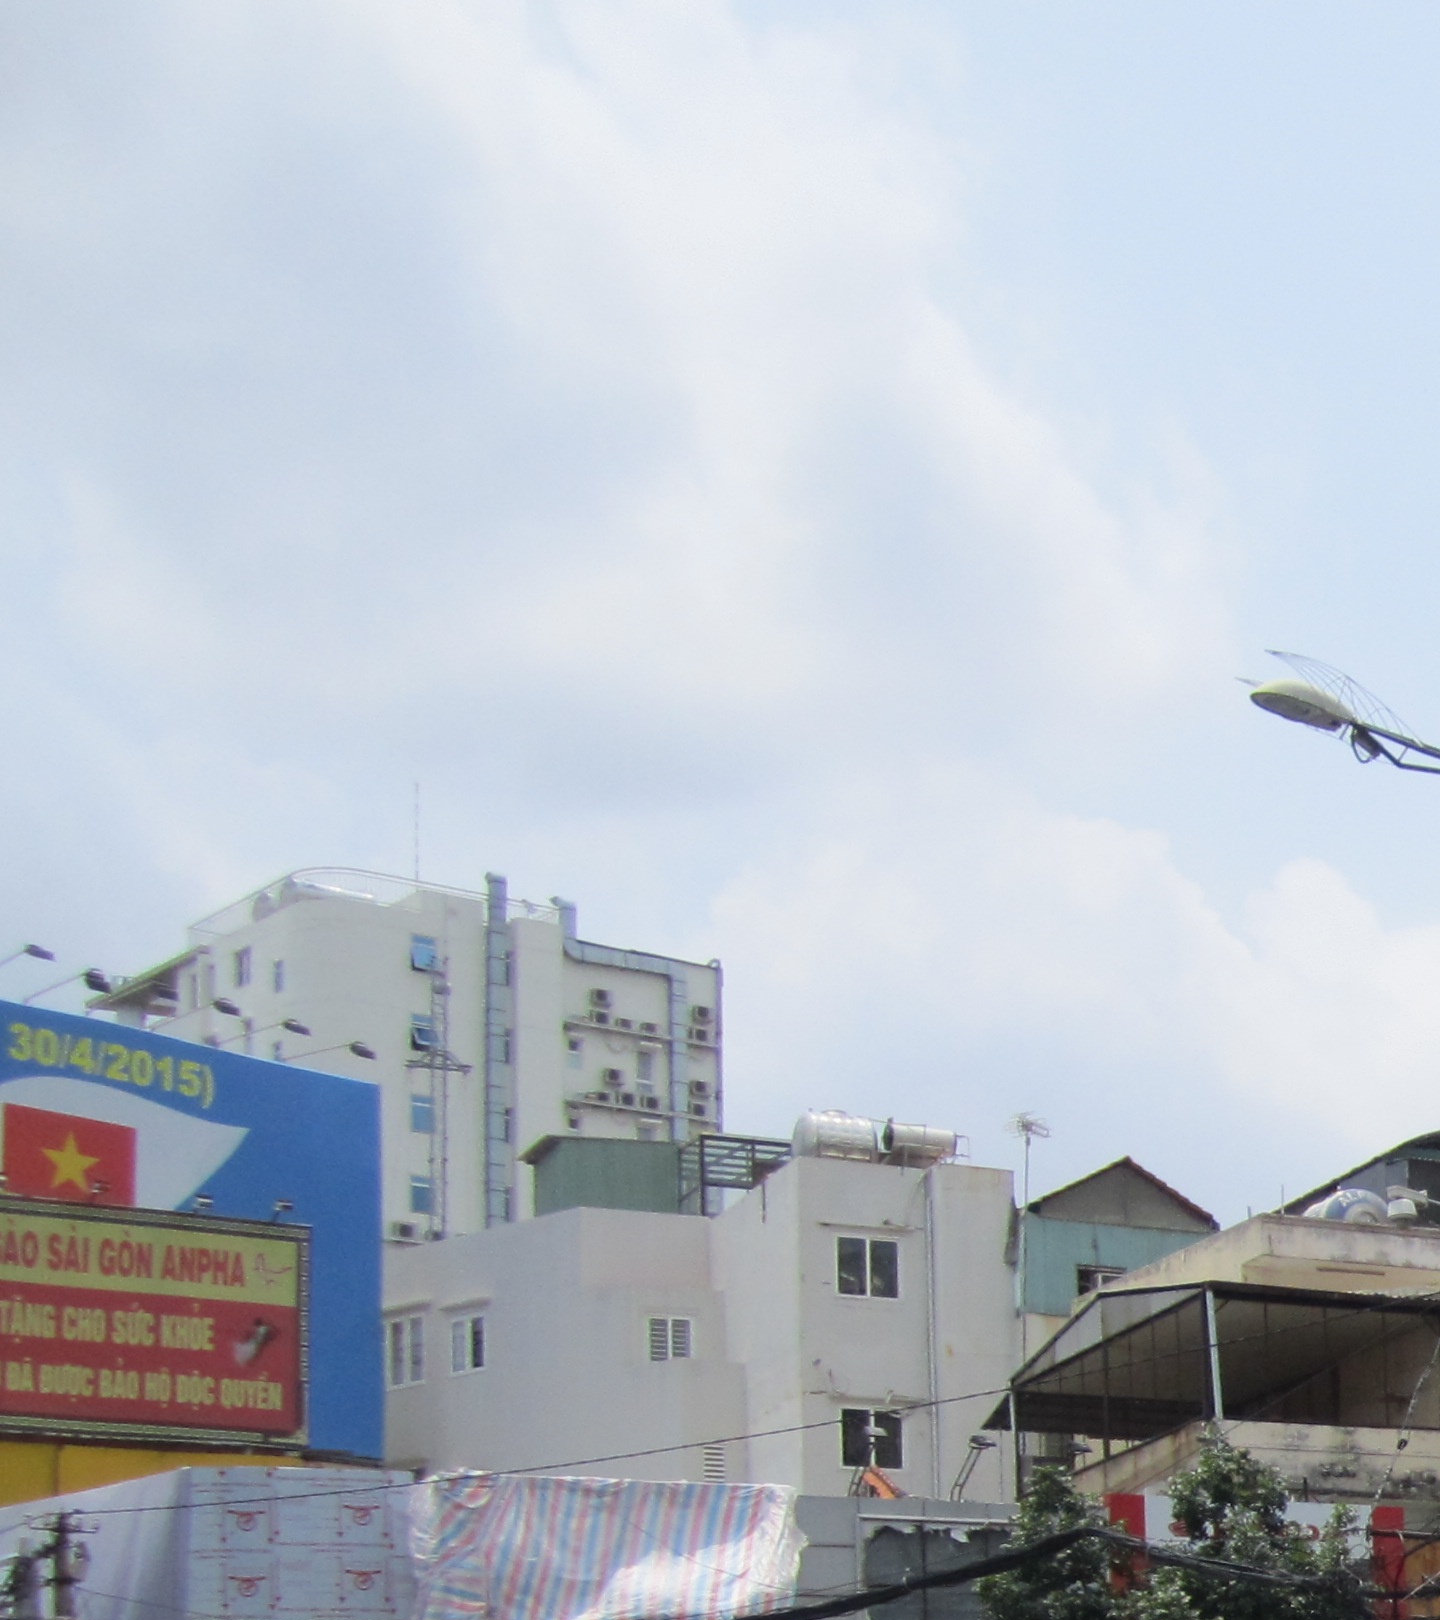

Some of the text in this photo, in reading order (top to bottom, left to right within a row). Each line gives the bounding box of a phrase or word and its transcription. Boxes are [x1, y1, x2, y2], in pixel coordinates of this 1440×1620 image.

[8, 1022, 215, 1108] 30/4/2015)
[47, 1225, 91, 1274] SÀI
[99, 1229, 153, 1280] GÒN
[161, 1244, 247, 1289] ANPHA
[62, 1307, 106, 1343] CHO
